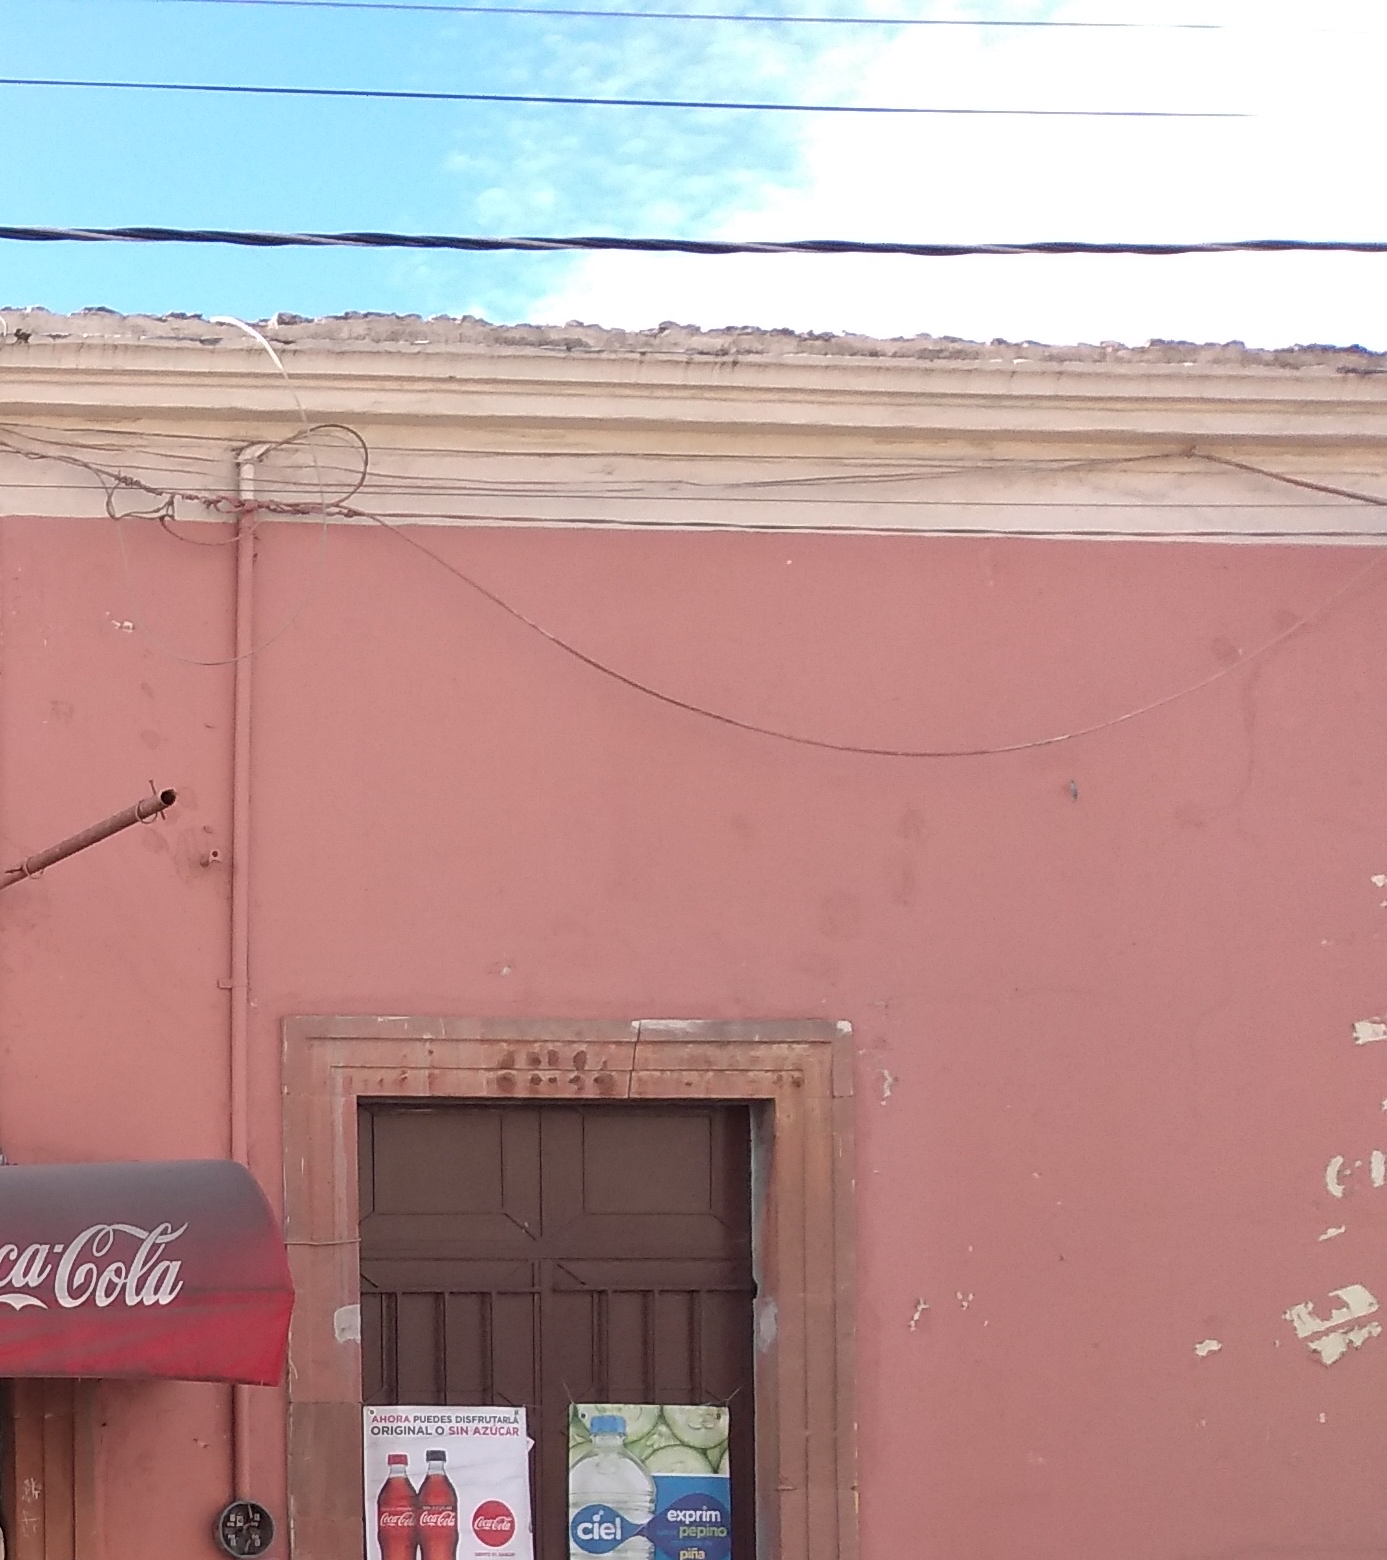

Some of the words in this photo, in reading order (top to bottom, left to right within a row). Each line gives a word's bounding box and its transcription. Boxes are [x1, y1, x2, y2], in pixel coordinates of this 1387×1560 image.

[371, 1414, 411, 1424] AHORA
[413, 1415, 453, 1424] PUEDES
[455, 1415, 520, 1425] DISFRUTARLA
[370, 1425, 433, 1436] ORIGINAL
[435, 1425, 445, 1436] O
[448, 1426, 469, 1436] SIN
[472, 1424, 520, 1437] AZÚCAR
[667, 1505, 721, 1525] exprim
[576, 1509, 622, 1541] ciel
[679, 1524, 728, 1539] pepino
